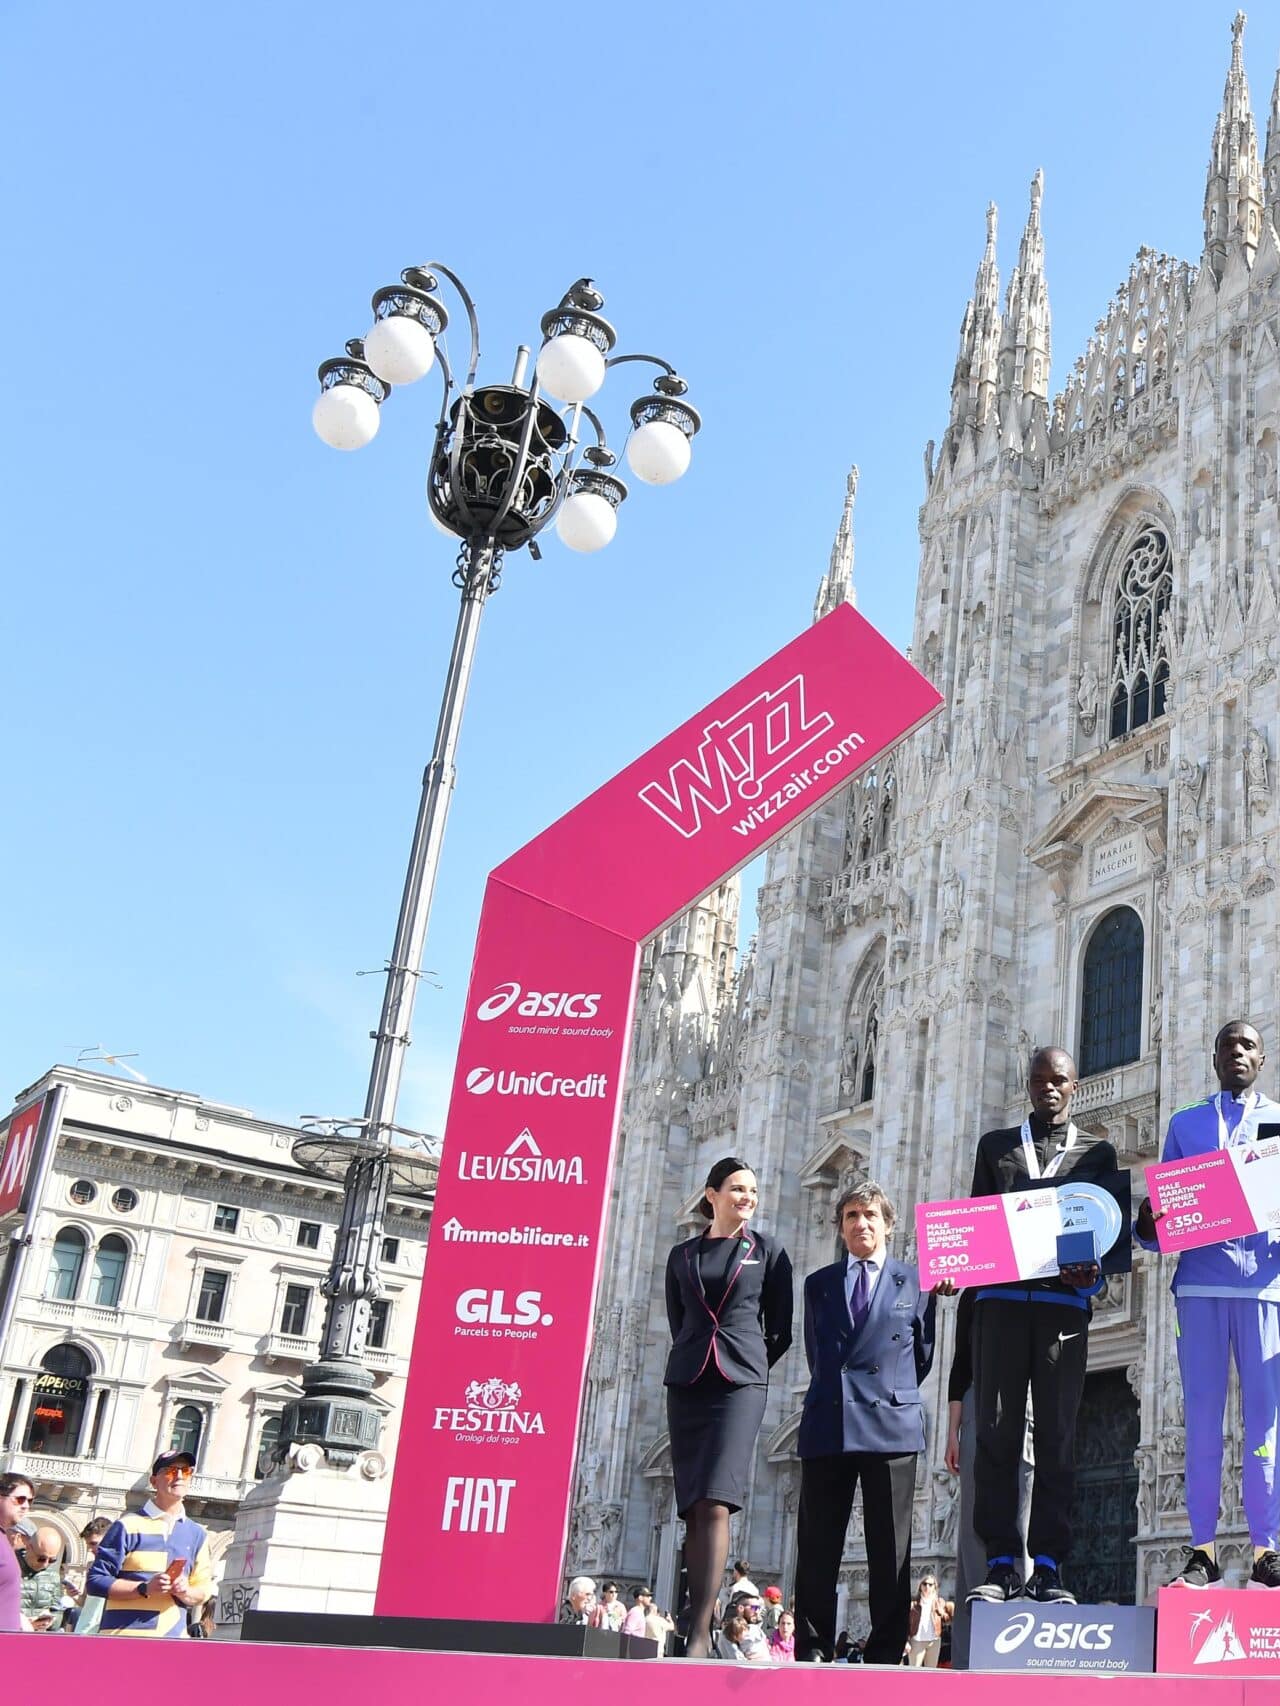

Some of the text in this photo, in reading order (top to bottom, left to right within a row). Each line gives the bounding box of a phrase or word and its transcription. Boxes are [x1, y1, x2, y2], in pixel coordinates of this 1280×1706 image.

[731, 732, 866, 836] wizzair.com
[1100, 840, 1133, 860] MARIAE
[1095, 853, 1137, 878] NASCENTI
[508, 1025, 614, 1039] sound mind sound body
[496, 1070, 608, 1098] UniCredit
[0, 1124, 33, 1194] M
[458, 1151, 583, 1185] LEVISSIMA
[1155, 1159, 1226, 1180] CONGRATULATIONS!
[1157, 1182, 1181, 1192] MALE
[1159, 1183, 1206, 1199] MARATHON
[1160, 1192, 1195, 1206] RUNNER
[1172, 1199, 1199, 1210] PLACE
[926, 1222, 950, 1230] MALE
[927, 1226, 975, 1237] MARATHON
[1167, 1218, 1233, 1237] WIZZ AIR VOUCHER
[927, 1234, 962, 1244] RUNNER
[942, 1240, 969, 1249] PLACE
[929, 1268, 948, 1276] WIZZ
[961, 1263, 996, 1272] VOUCHER
[454, 1327, 538, 1340] Parcels to People
[36, 1375, 83, 1391] APEROL
[432, 1407, 546, 1435] FESTINA
[455, 1433, 520, 1445] Orologi dal 1902
[441, 1476, 517, 1534] FIAT
[1249, 1627, 1280, 1639] WIZZ
[1027, 1658, 1129, 1671] sound mind sound body
